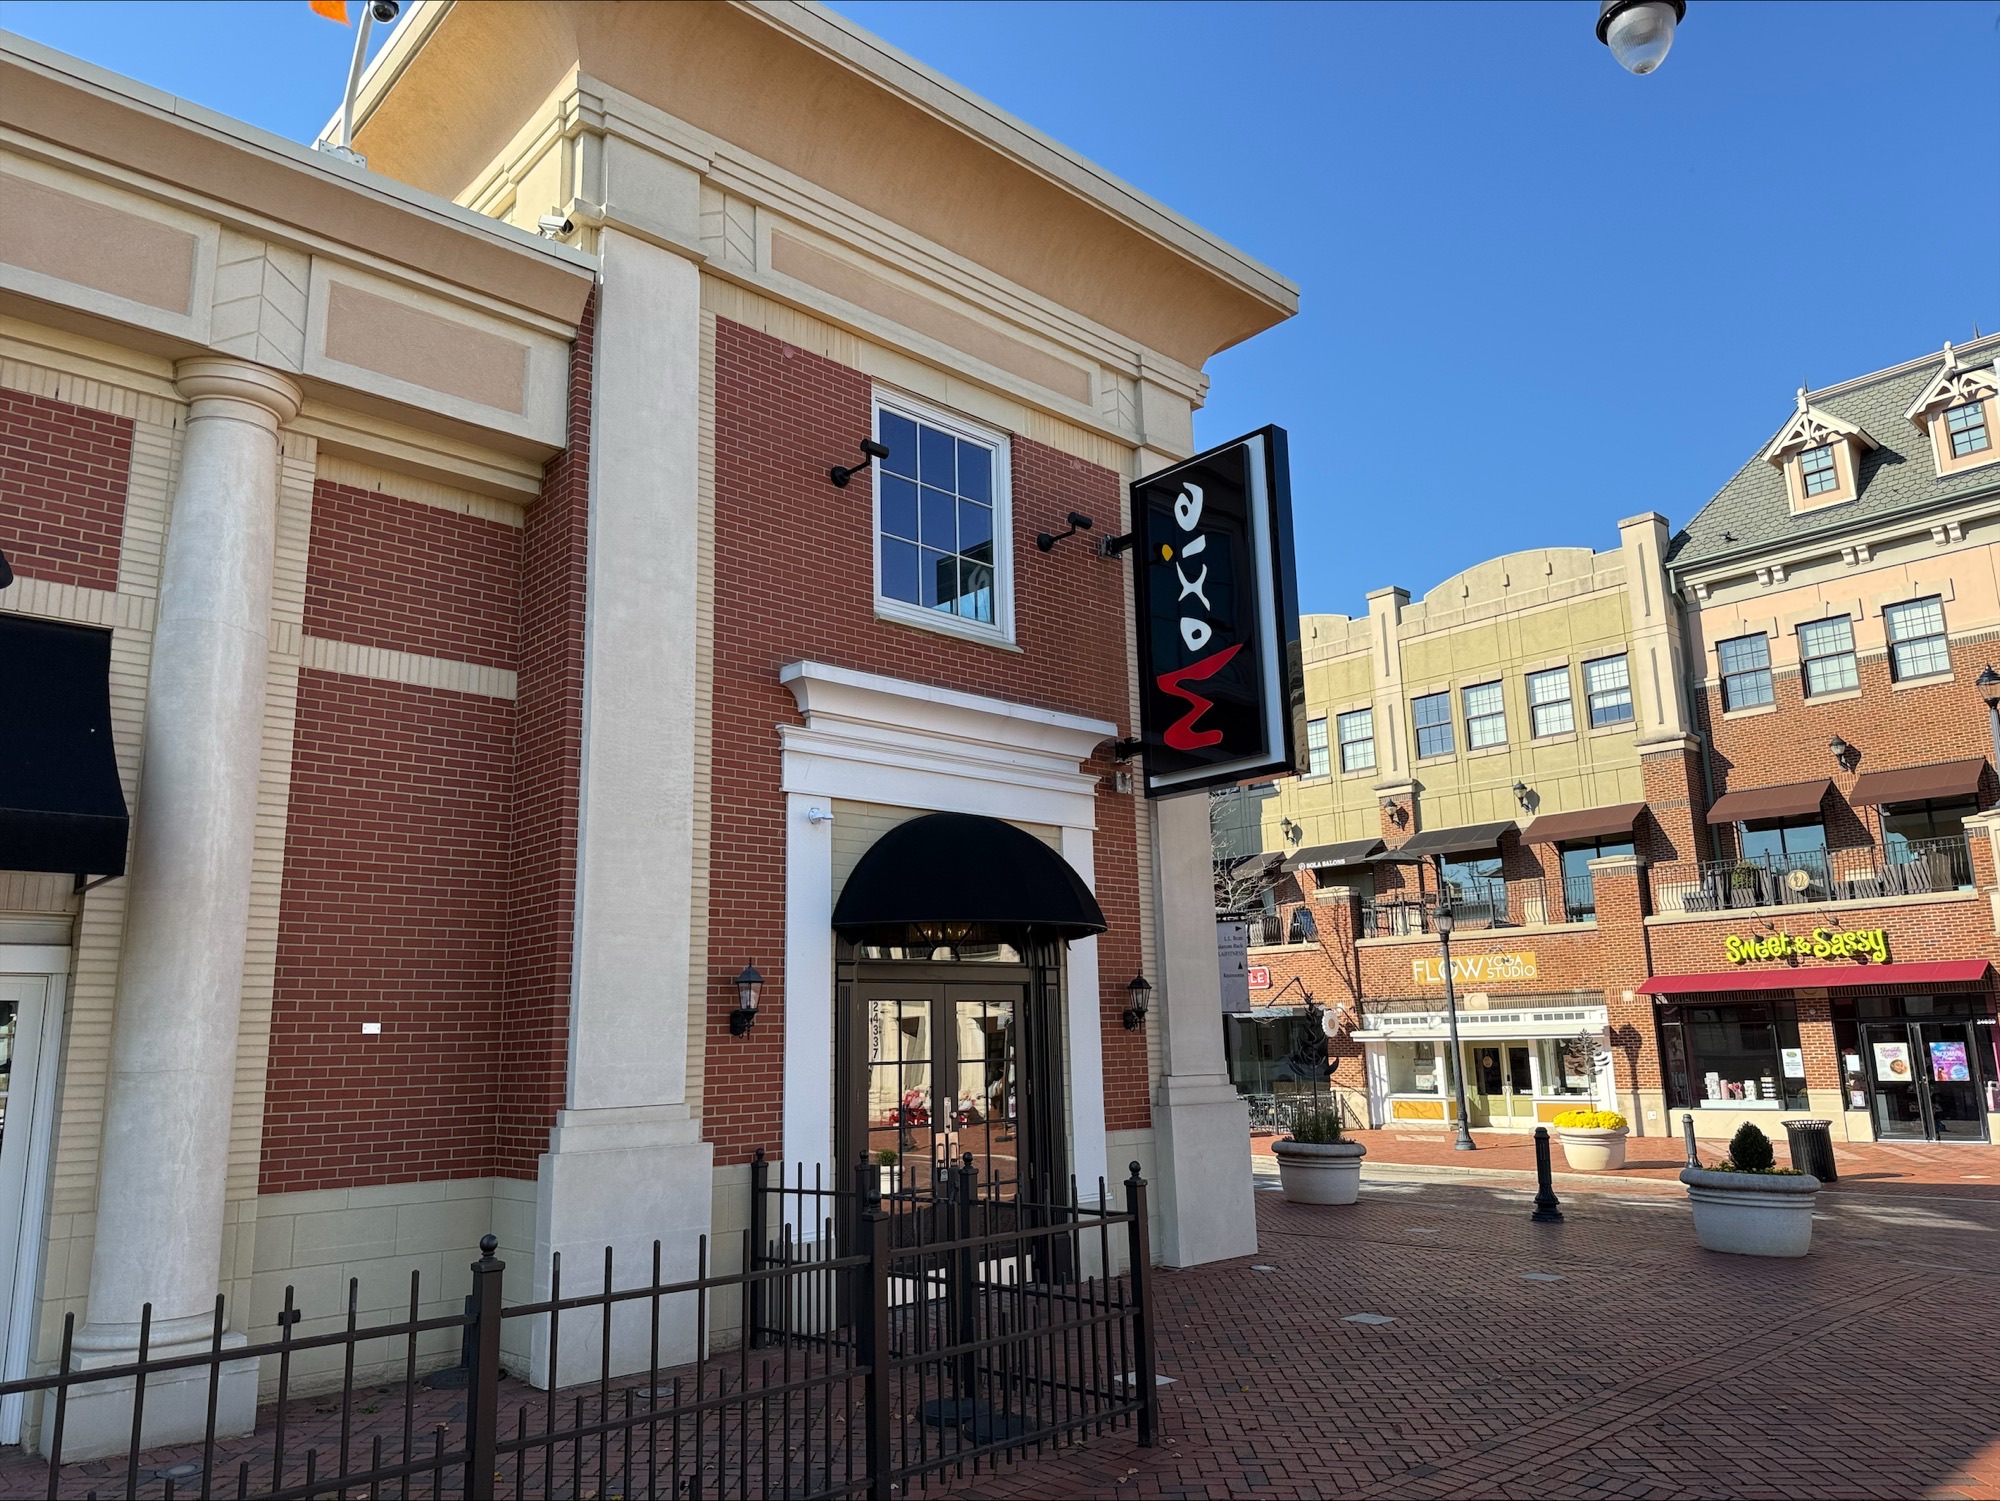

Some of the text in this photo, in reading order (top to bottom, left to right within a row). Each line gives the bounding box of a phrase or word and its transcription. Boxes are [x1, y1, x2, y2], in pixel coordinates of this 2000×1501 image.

[1322, 859, 1346, 867] SALONS
[1726, 927, 1887, 963] Sweet & Sassy
[1486, 954, 1524, 967] YOGA
[1412, 957, 1484, 982] FLOW
[1487, 965, 1536, 979] STUDIO
